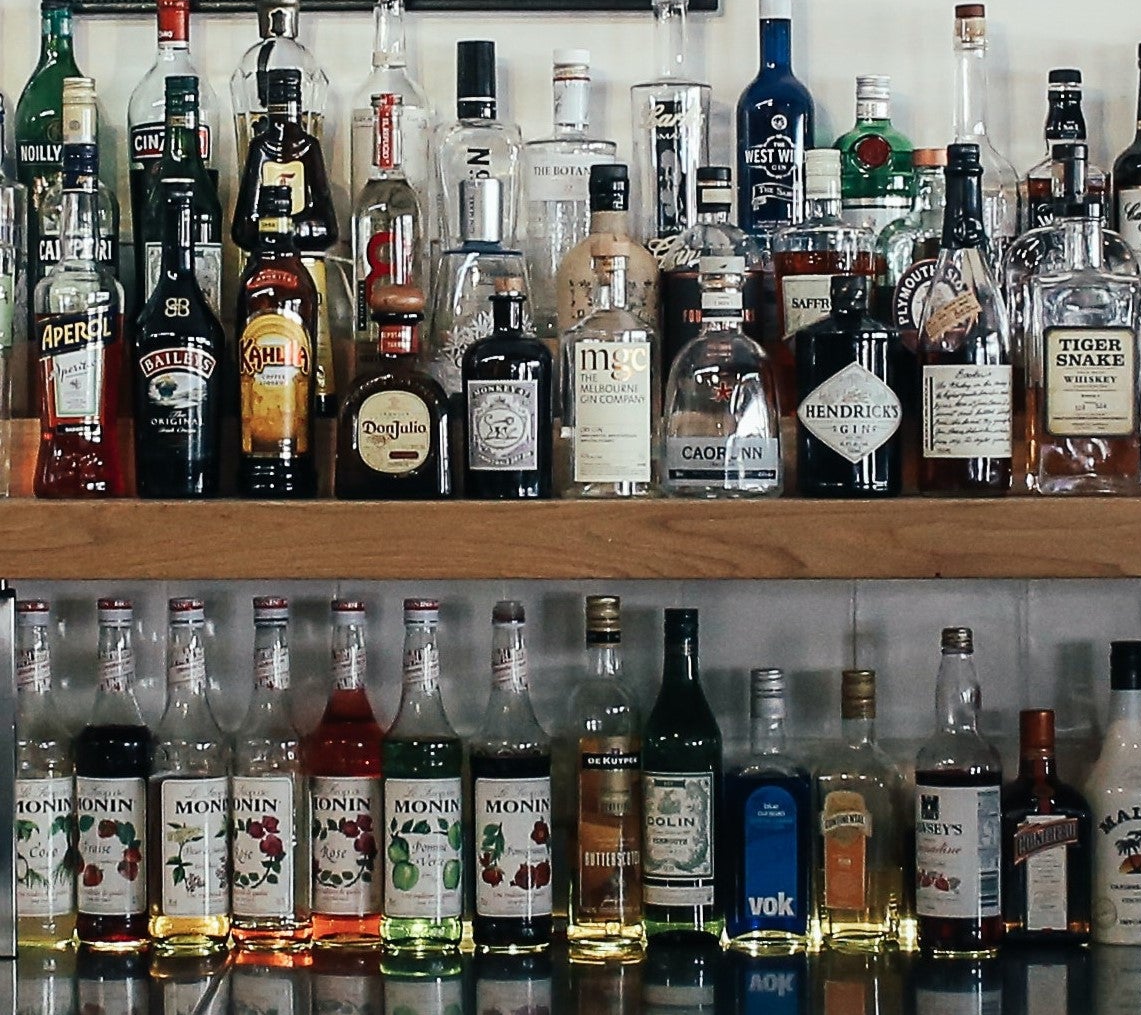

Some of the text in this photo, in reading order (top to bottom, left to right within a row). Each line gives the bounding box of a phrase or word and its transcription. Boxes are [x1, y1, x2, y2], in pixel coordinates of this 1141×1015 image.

[19, 143, 62, 163] NOILLY
[745, 148, 774, 164] WEST
[533, 166, 550, 177] THE
[41, 321, 113, 351] APEROL
[1058, 338, 1122, 352] TIGER
[143, 349, 210, 372] BAILEYS
[579, 347, 646, 382] mgc
[1055, 353, 1125, 368] SNAKE
[579, 374, 598, 384] THE
[1063, 375, 1117, 384] WHISKEY
[579, 384, 639, 395] MELBOURNE
[579, 394, 646, 405] GIN COMPANY
[805, 404, 900, 419] HENDRICK'S
[839, 424, 871, 435] GIN
[394, 799, 460, 815] MONIN
[485, 799, 551, 815] MONIN
[747, 891, 795, 917] vok
